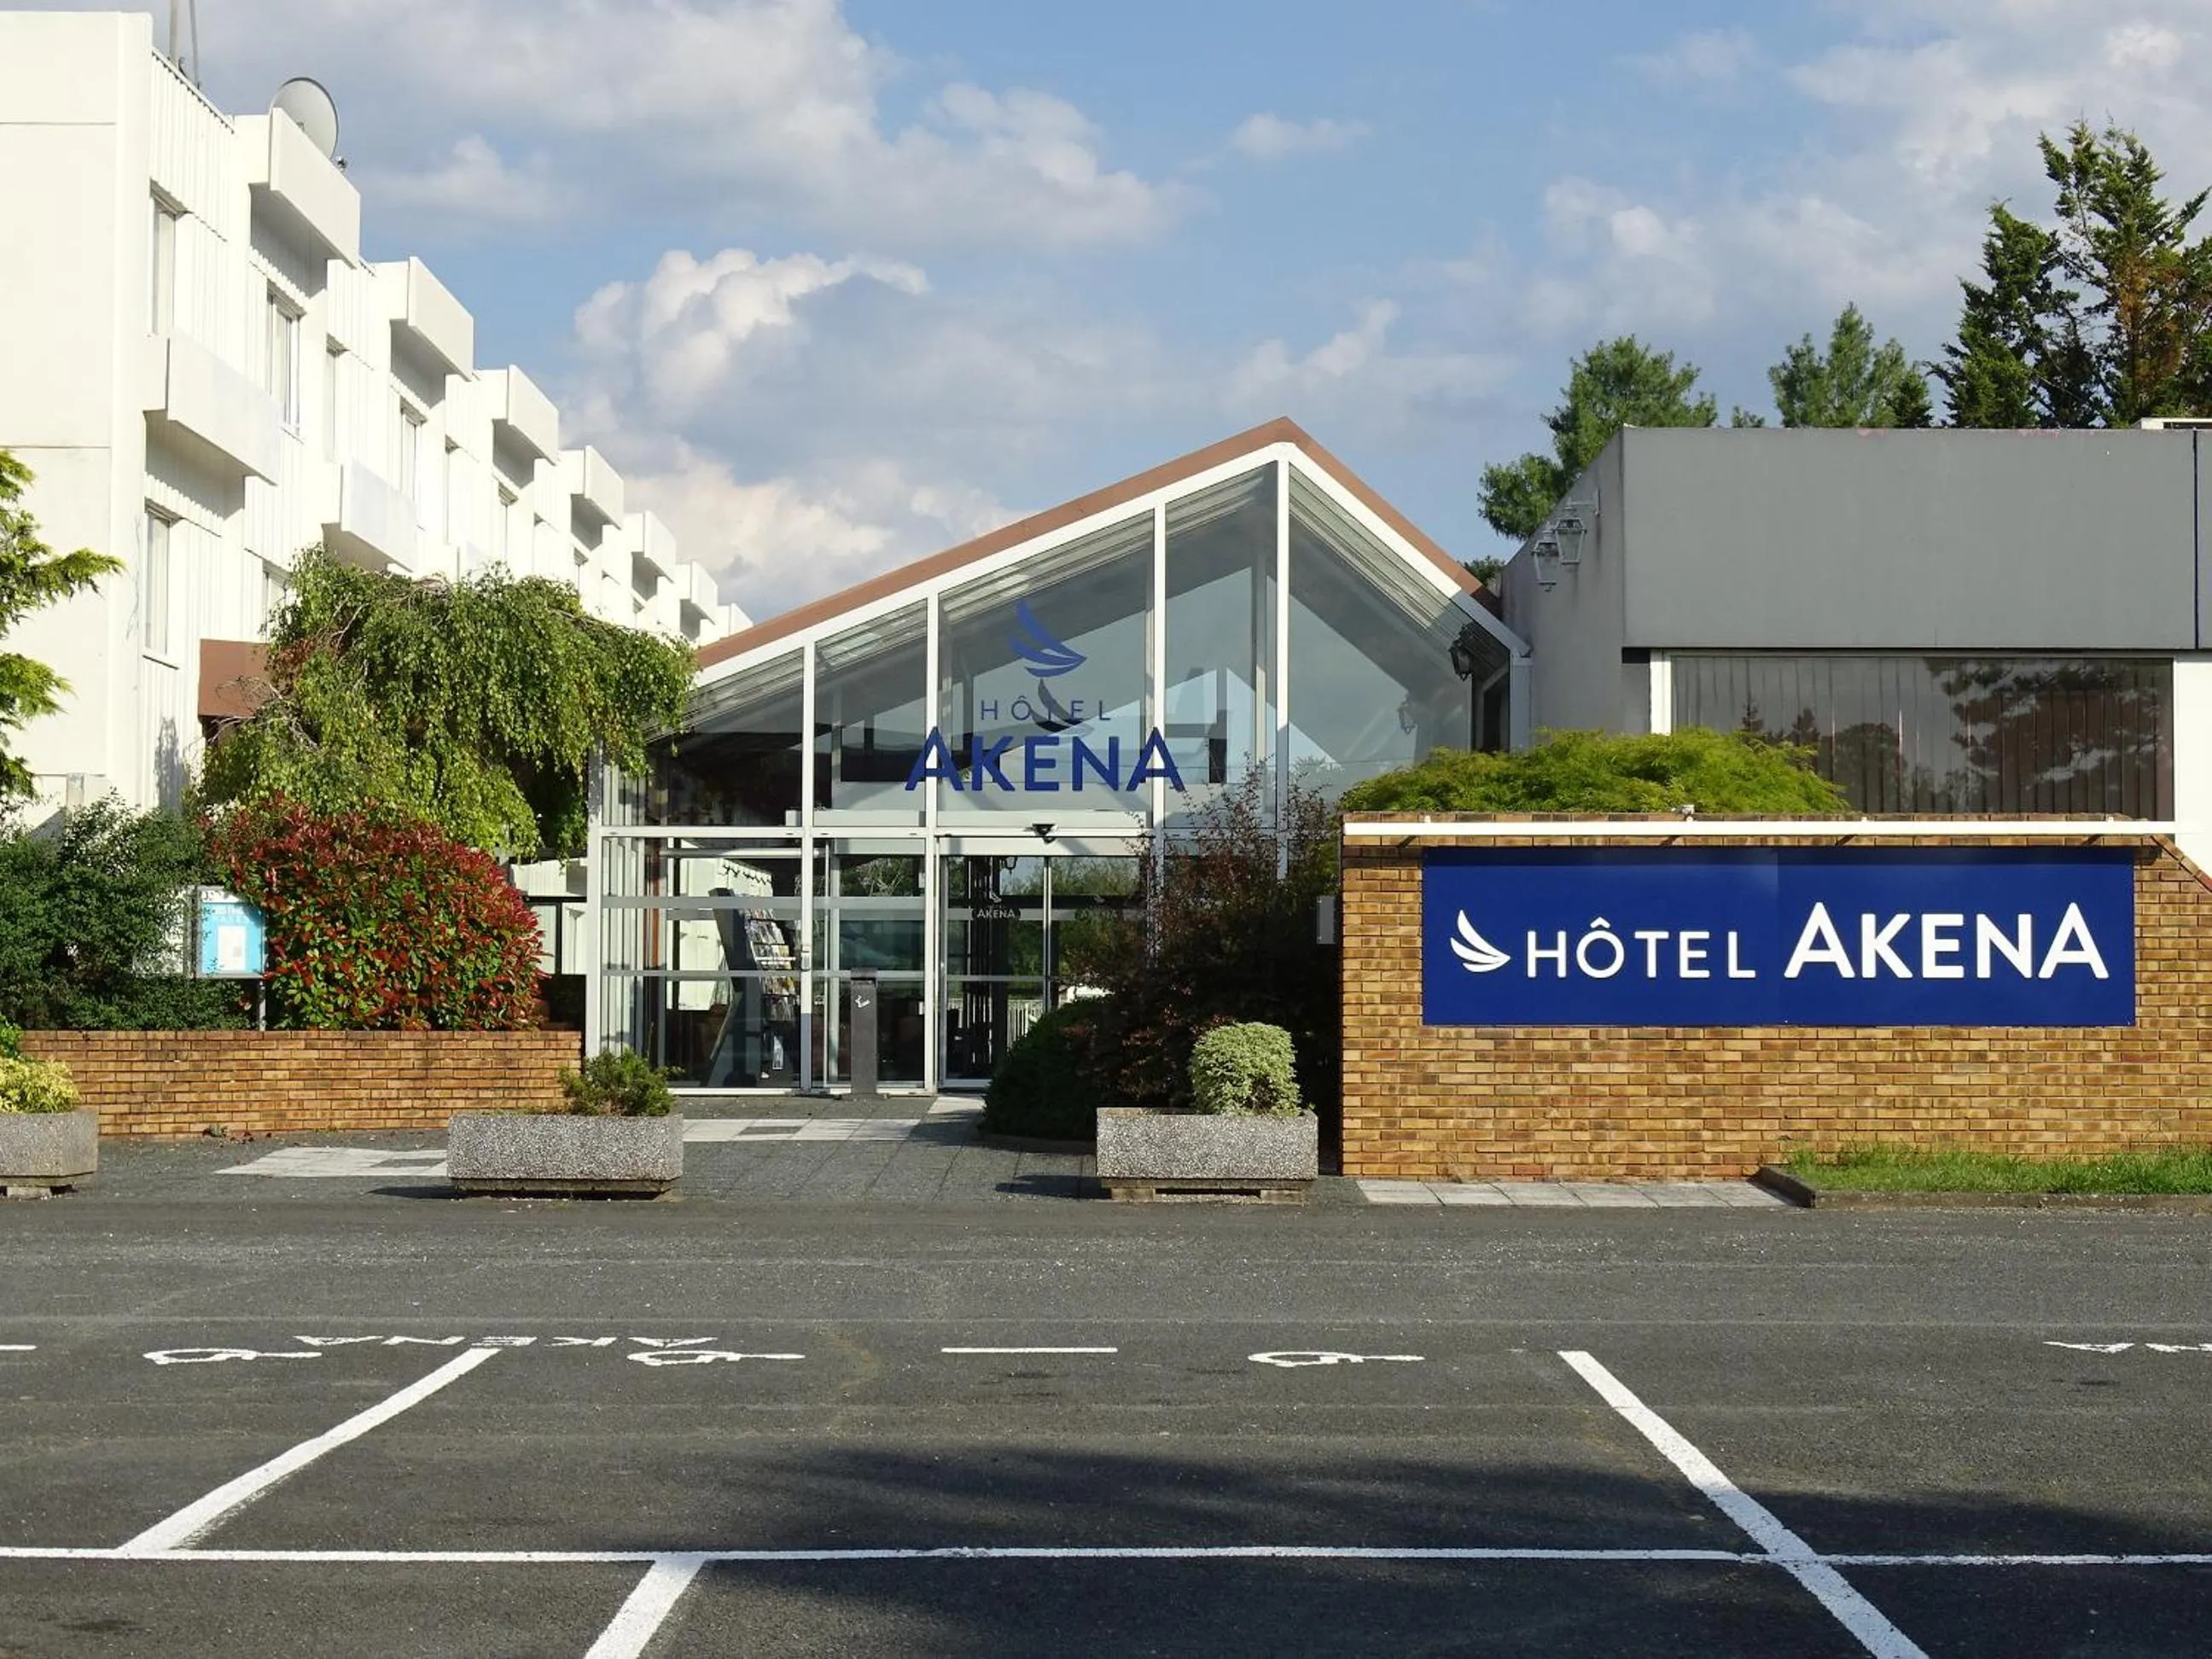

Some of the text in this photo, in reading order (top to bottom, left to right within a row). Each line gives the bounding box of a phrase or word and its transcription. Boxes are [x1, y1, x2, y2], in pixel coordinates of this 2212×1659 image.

[905, 725, 1186, 792] AKENA
[976, 908, 1016, 919] AKENA
[1526, 901, 2110, 980] HÔTEL AKENA
[294, 1335, 719, 1348] AKENA
